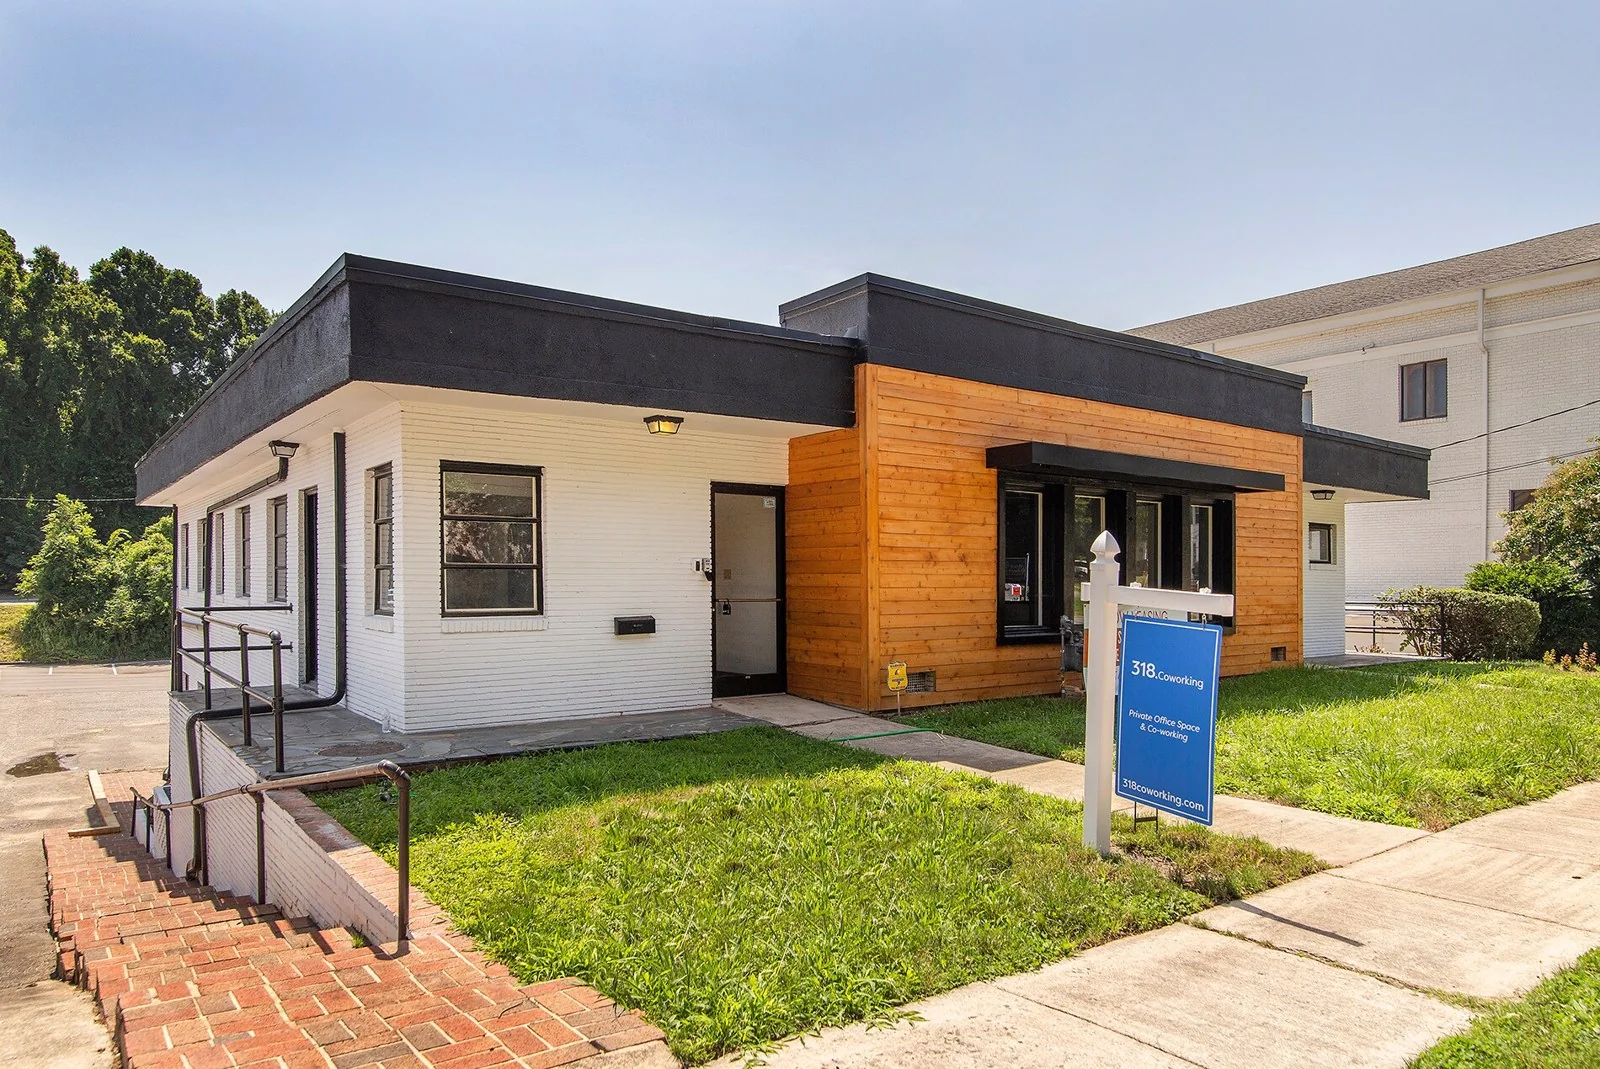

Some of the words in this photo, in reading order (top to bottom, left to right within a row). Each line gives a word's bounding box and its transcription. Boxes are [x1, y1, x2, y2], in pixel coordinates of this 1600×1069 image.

[1128, 709, 1153, 722] Private
[1153, 715, 1176, 727] Office
[1176, 720, 1201, 733] Space
[1139, 722, 1146, 731] &
[1147, 724, 1189, 743] Co-working
[1122, 777, 1205, 812] 318coworking.com
